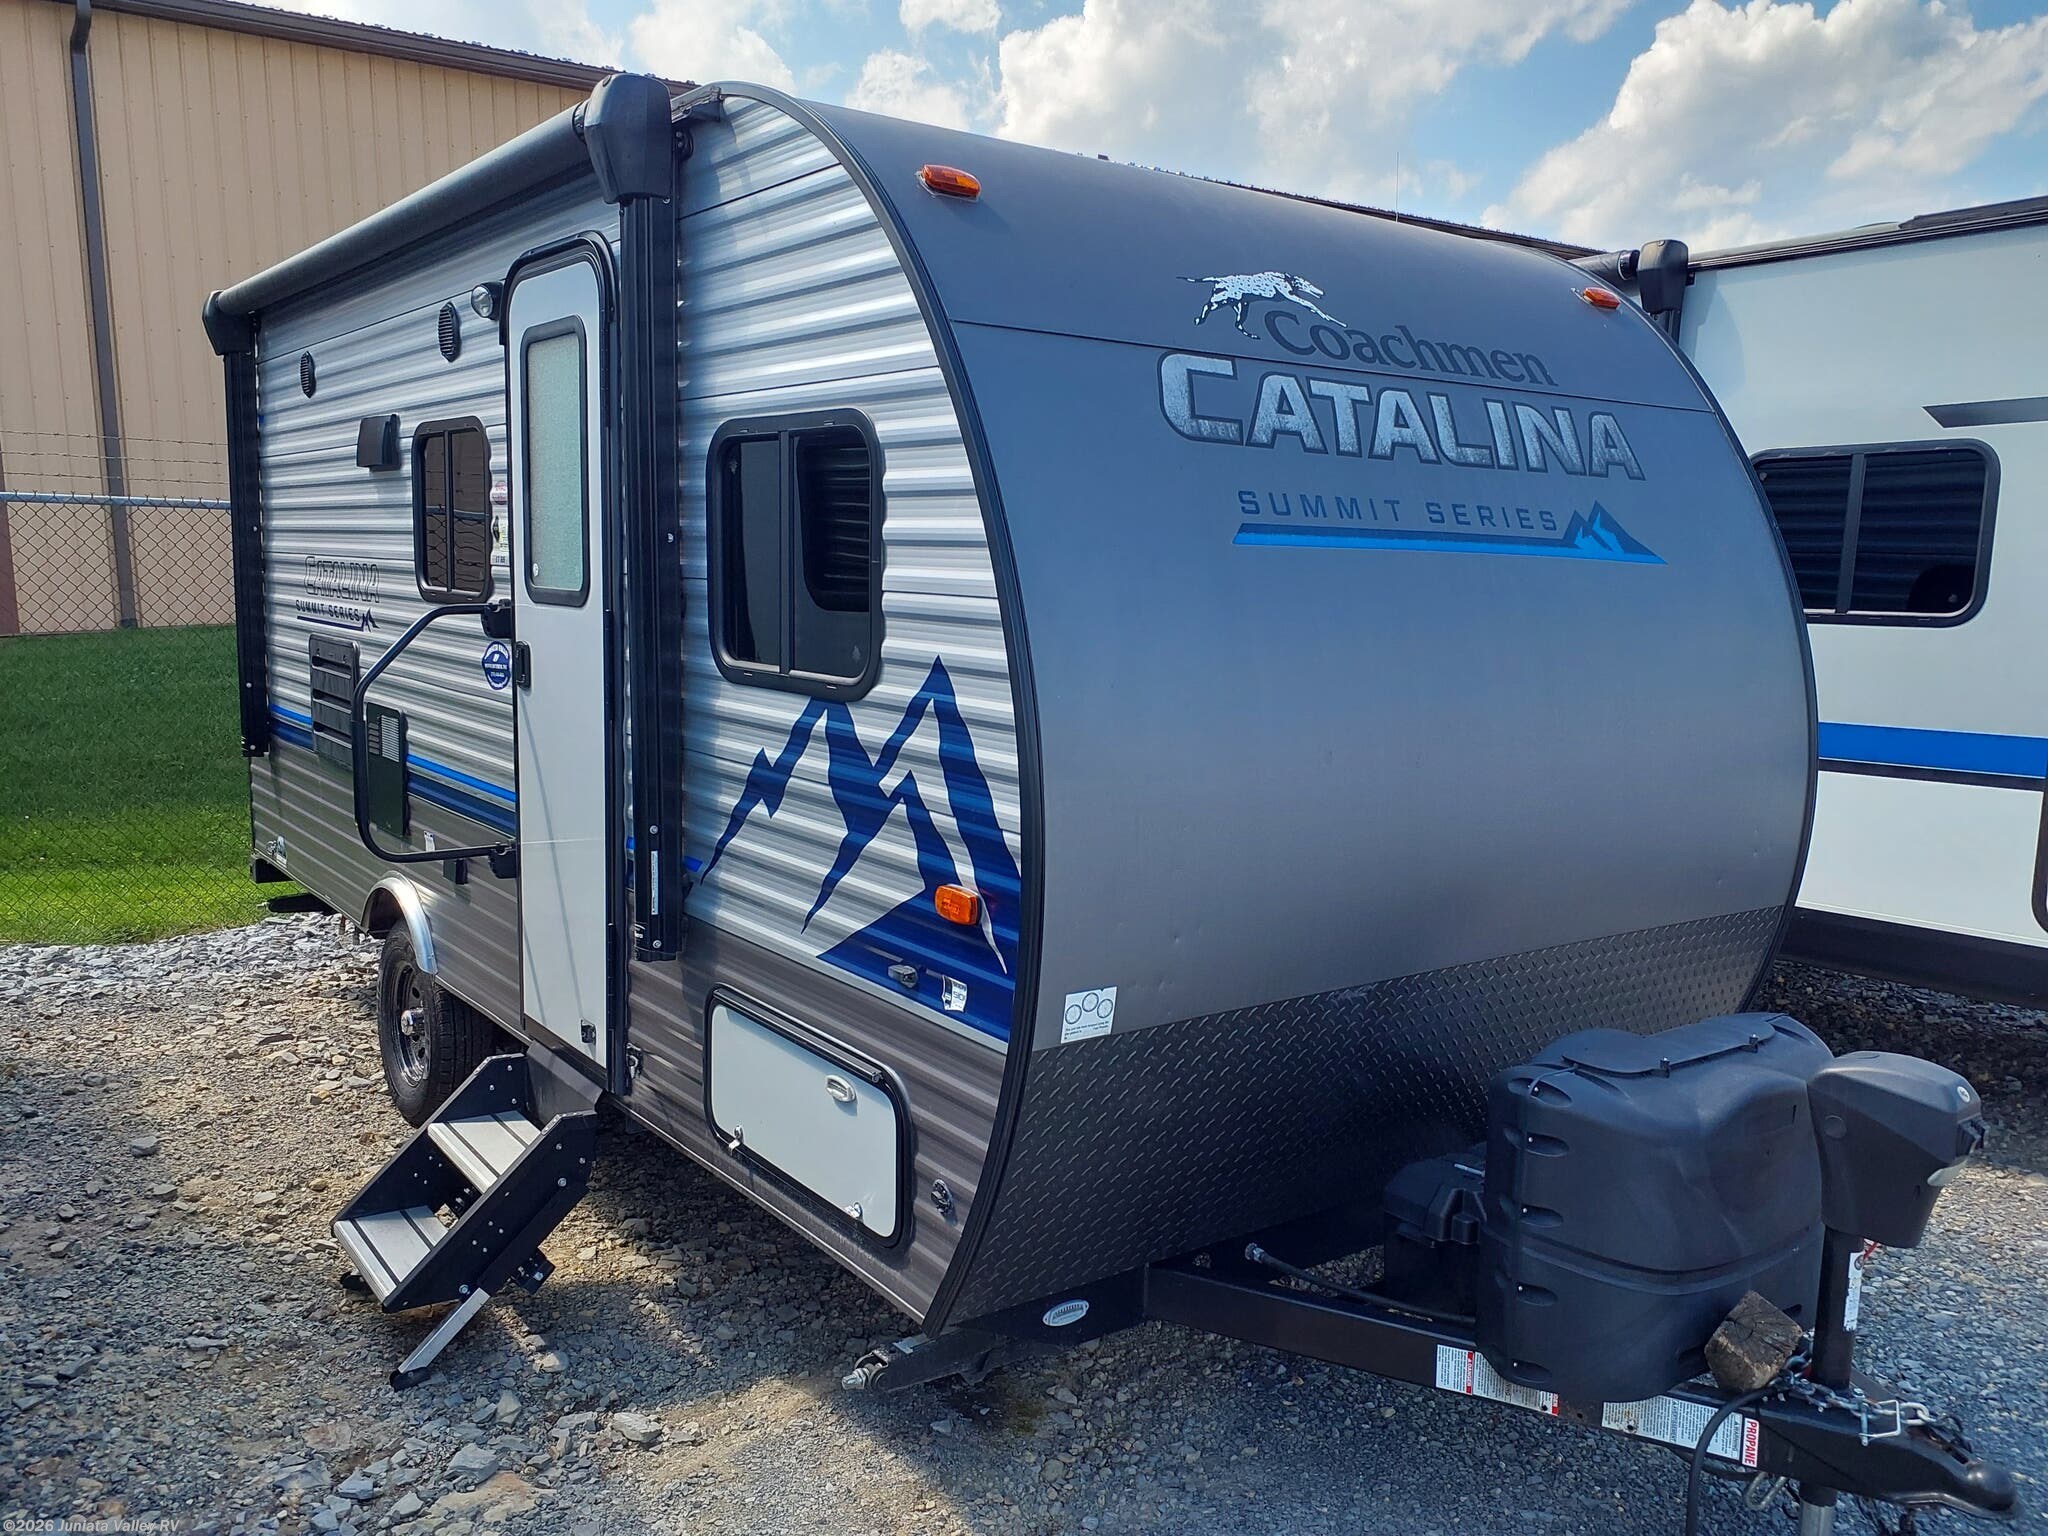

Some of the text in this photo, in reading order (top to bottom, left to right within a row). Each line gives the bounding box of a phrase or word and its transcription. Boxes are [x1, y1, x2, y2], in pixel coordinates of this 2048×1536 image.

[1264, 309, 1559, 387] Coachmen
[1157, 350, 1647, 481] CATALINA
[1238, 490, 1558, 532] SUMMIT SERIES
[304, 556, 380, 604] CATALINA
[295, 599, 361, 622] SUMMIT SERIES
[1744, 1421, 1758, 1465] PROPANE
